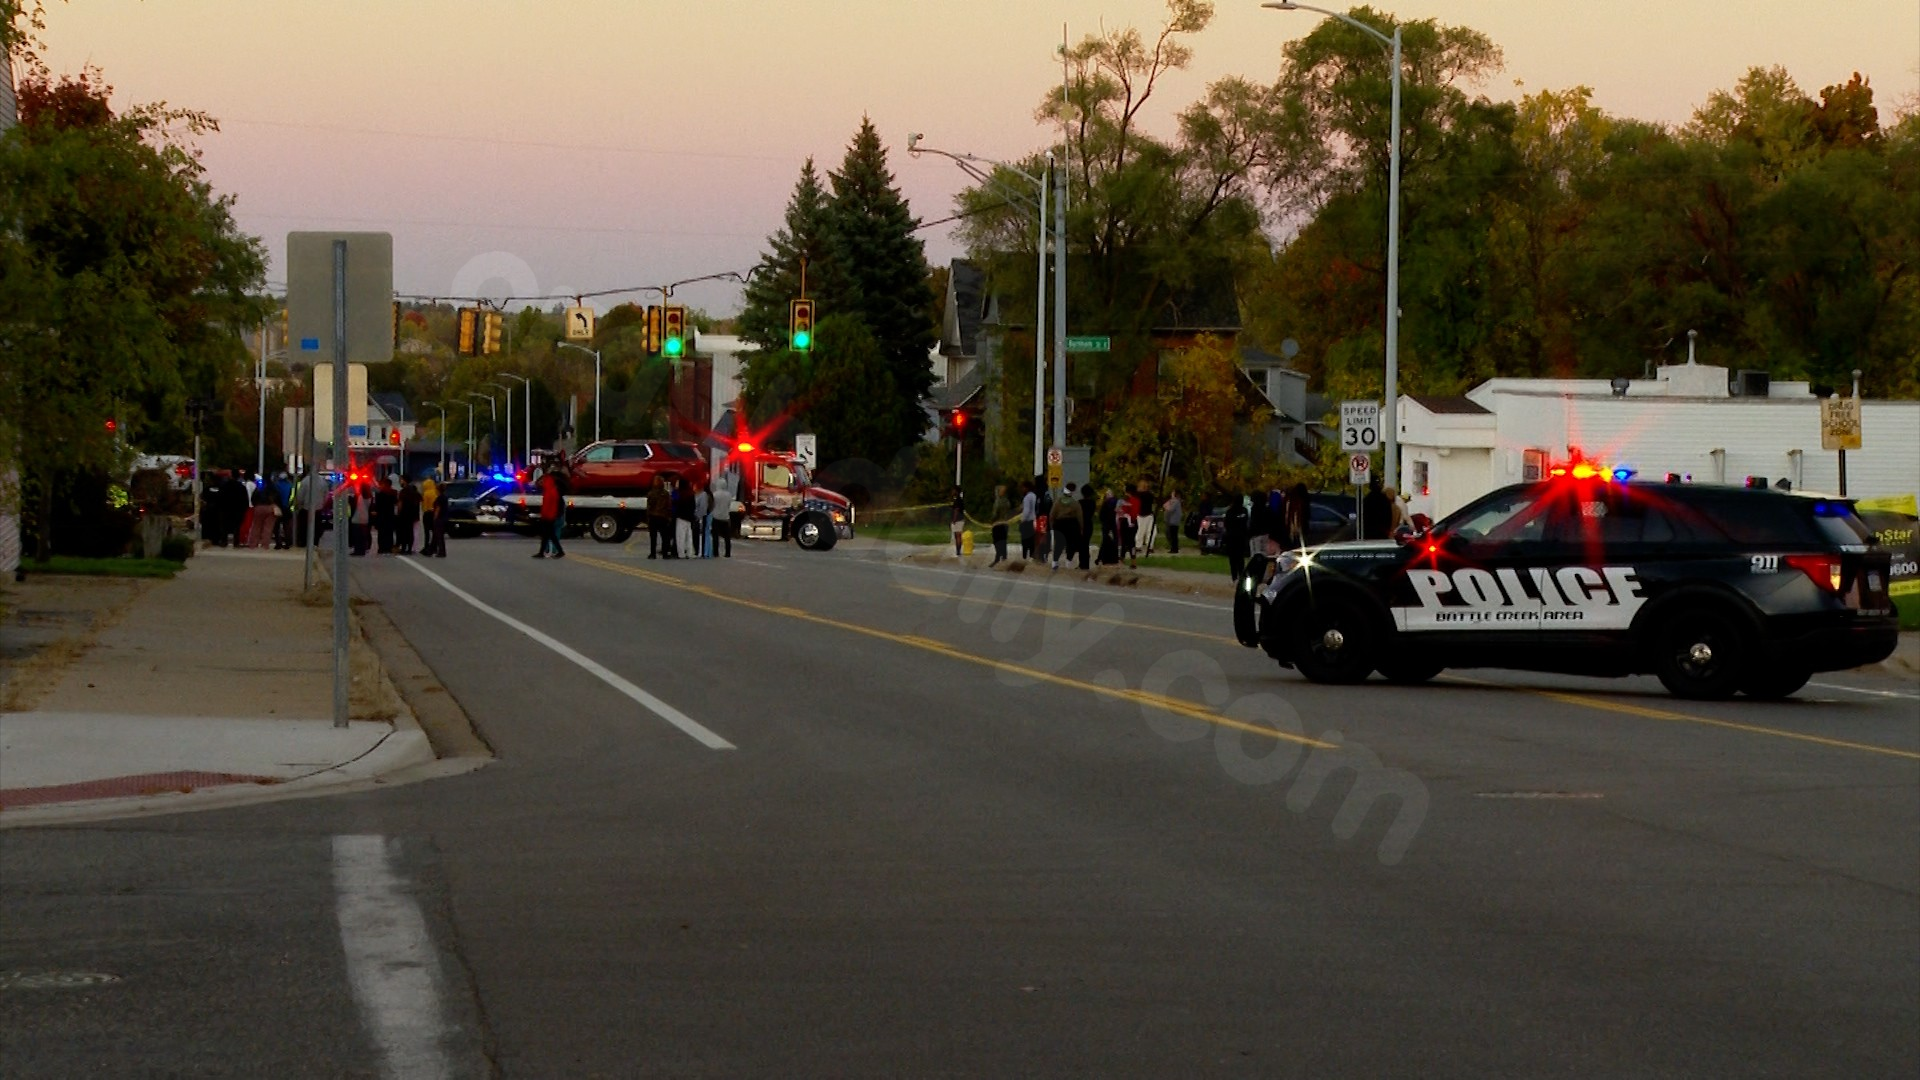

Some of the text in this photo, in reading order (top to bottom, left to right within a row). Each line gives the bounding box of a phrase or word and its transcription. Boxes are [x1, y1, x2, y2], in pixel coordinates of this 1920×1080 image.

[1343, 407, 1377, 416] SPEED
[1346, 417, 1372, 426] LIMIT
[1822, 419, 1860, 428] SCHOOL
[1345, 427, 1376, 446] 30
[1751, 555, 1778, 568] 911
[1406, 566, 1648, 607] POLICE
[1436, 611, 1584, 622] BATTLE CREEK AREA
